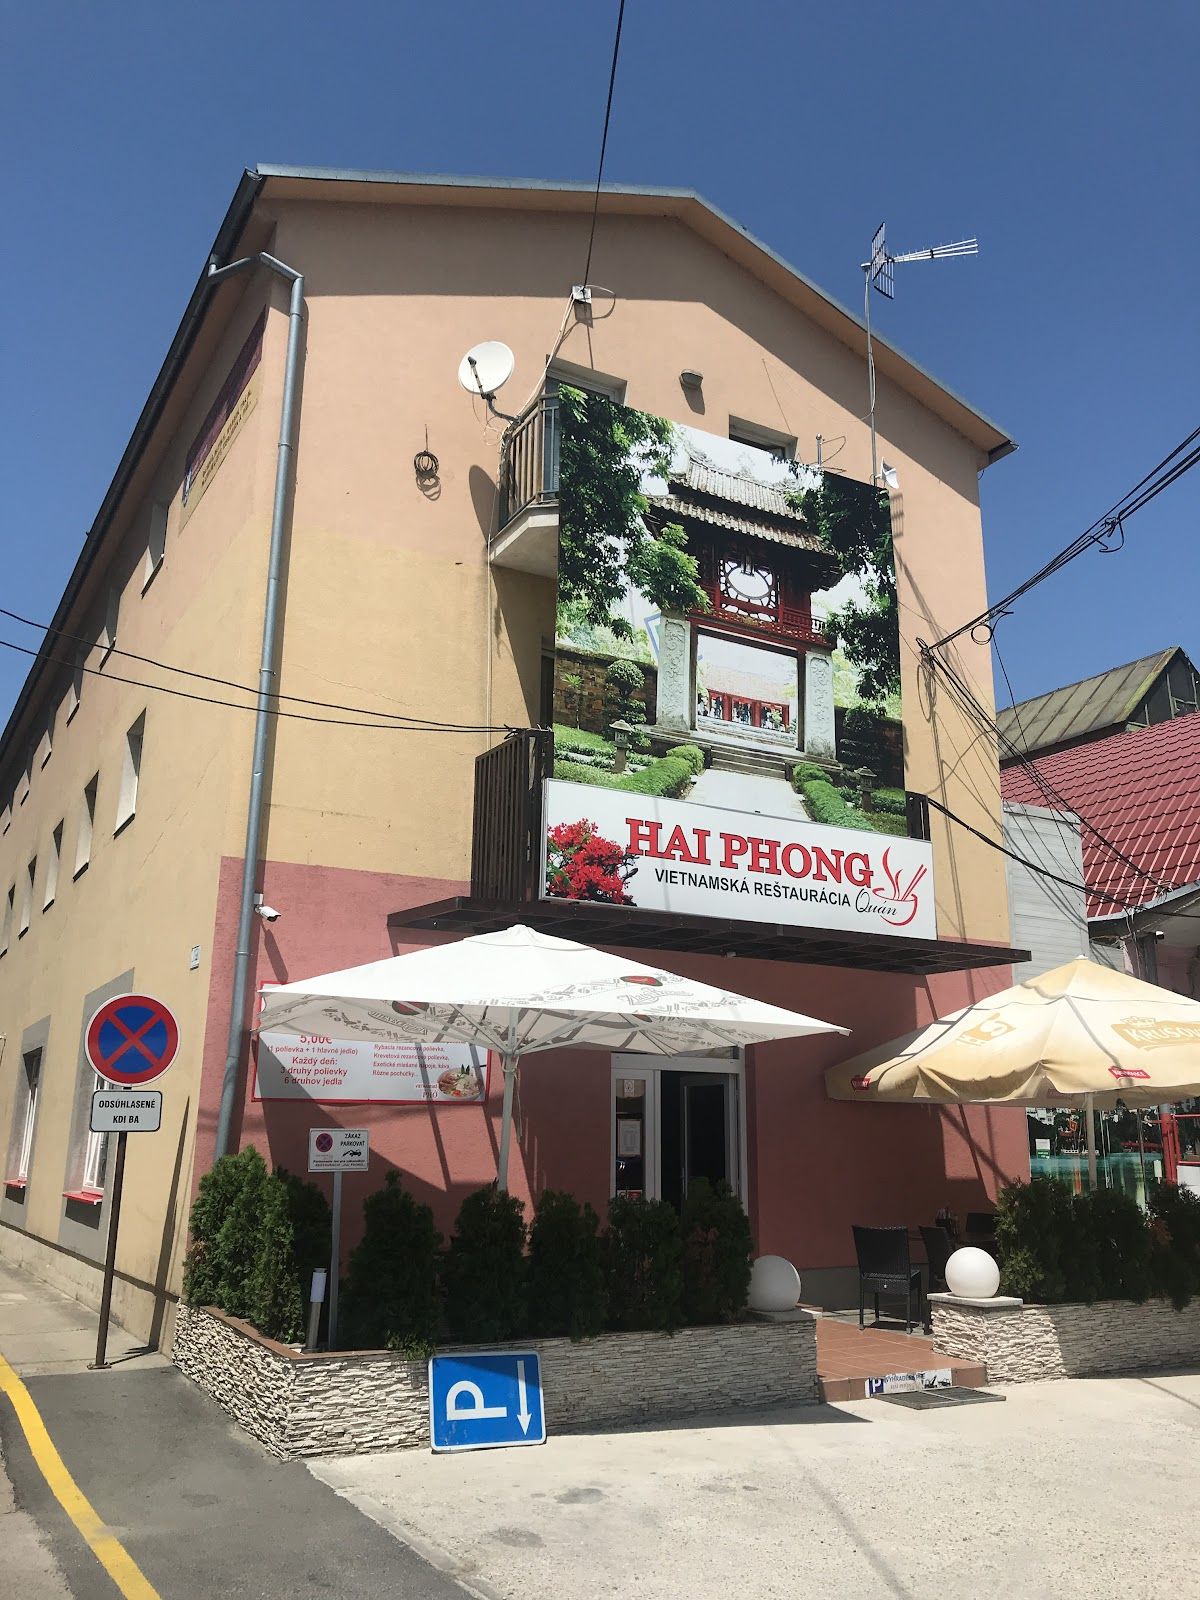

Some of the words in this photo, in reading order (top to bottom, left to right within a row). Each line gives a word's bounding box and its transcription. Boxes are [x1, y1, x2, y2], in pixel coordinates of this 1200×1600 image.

[625, 817, 711, 866] HAI
[719, 832, 874, 888] PHONG
[654, 867, 750, 895] VIETNAMSKÁ
[754, 880, 851, 908] REŠTAURÁCIA
[855, 887, 898, 917] Quán
[275, 1047, 304, 1055] polievka
[292, 1057, 318, 1066] Každý
[320, 1057, 338, 1065] deň:
[287, 1066, 312, 1076] druhy
[314, 1069, 348, 1077] polievky
[291, 1077, 321, 1085] druhov
[322, 1078, 343, 1087] jedla
[99, 1099, 156, 1109] ODSÚHLASENÉ
[112, 1116, 127, 1124] KDI
[128, 1116, 139, 1124] BA
[446, 1380, 508, 1421] P
